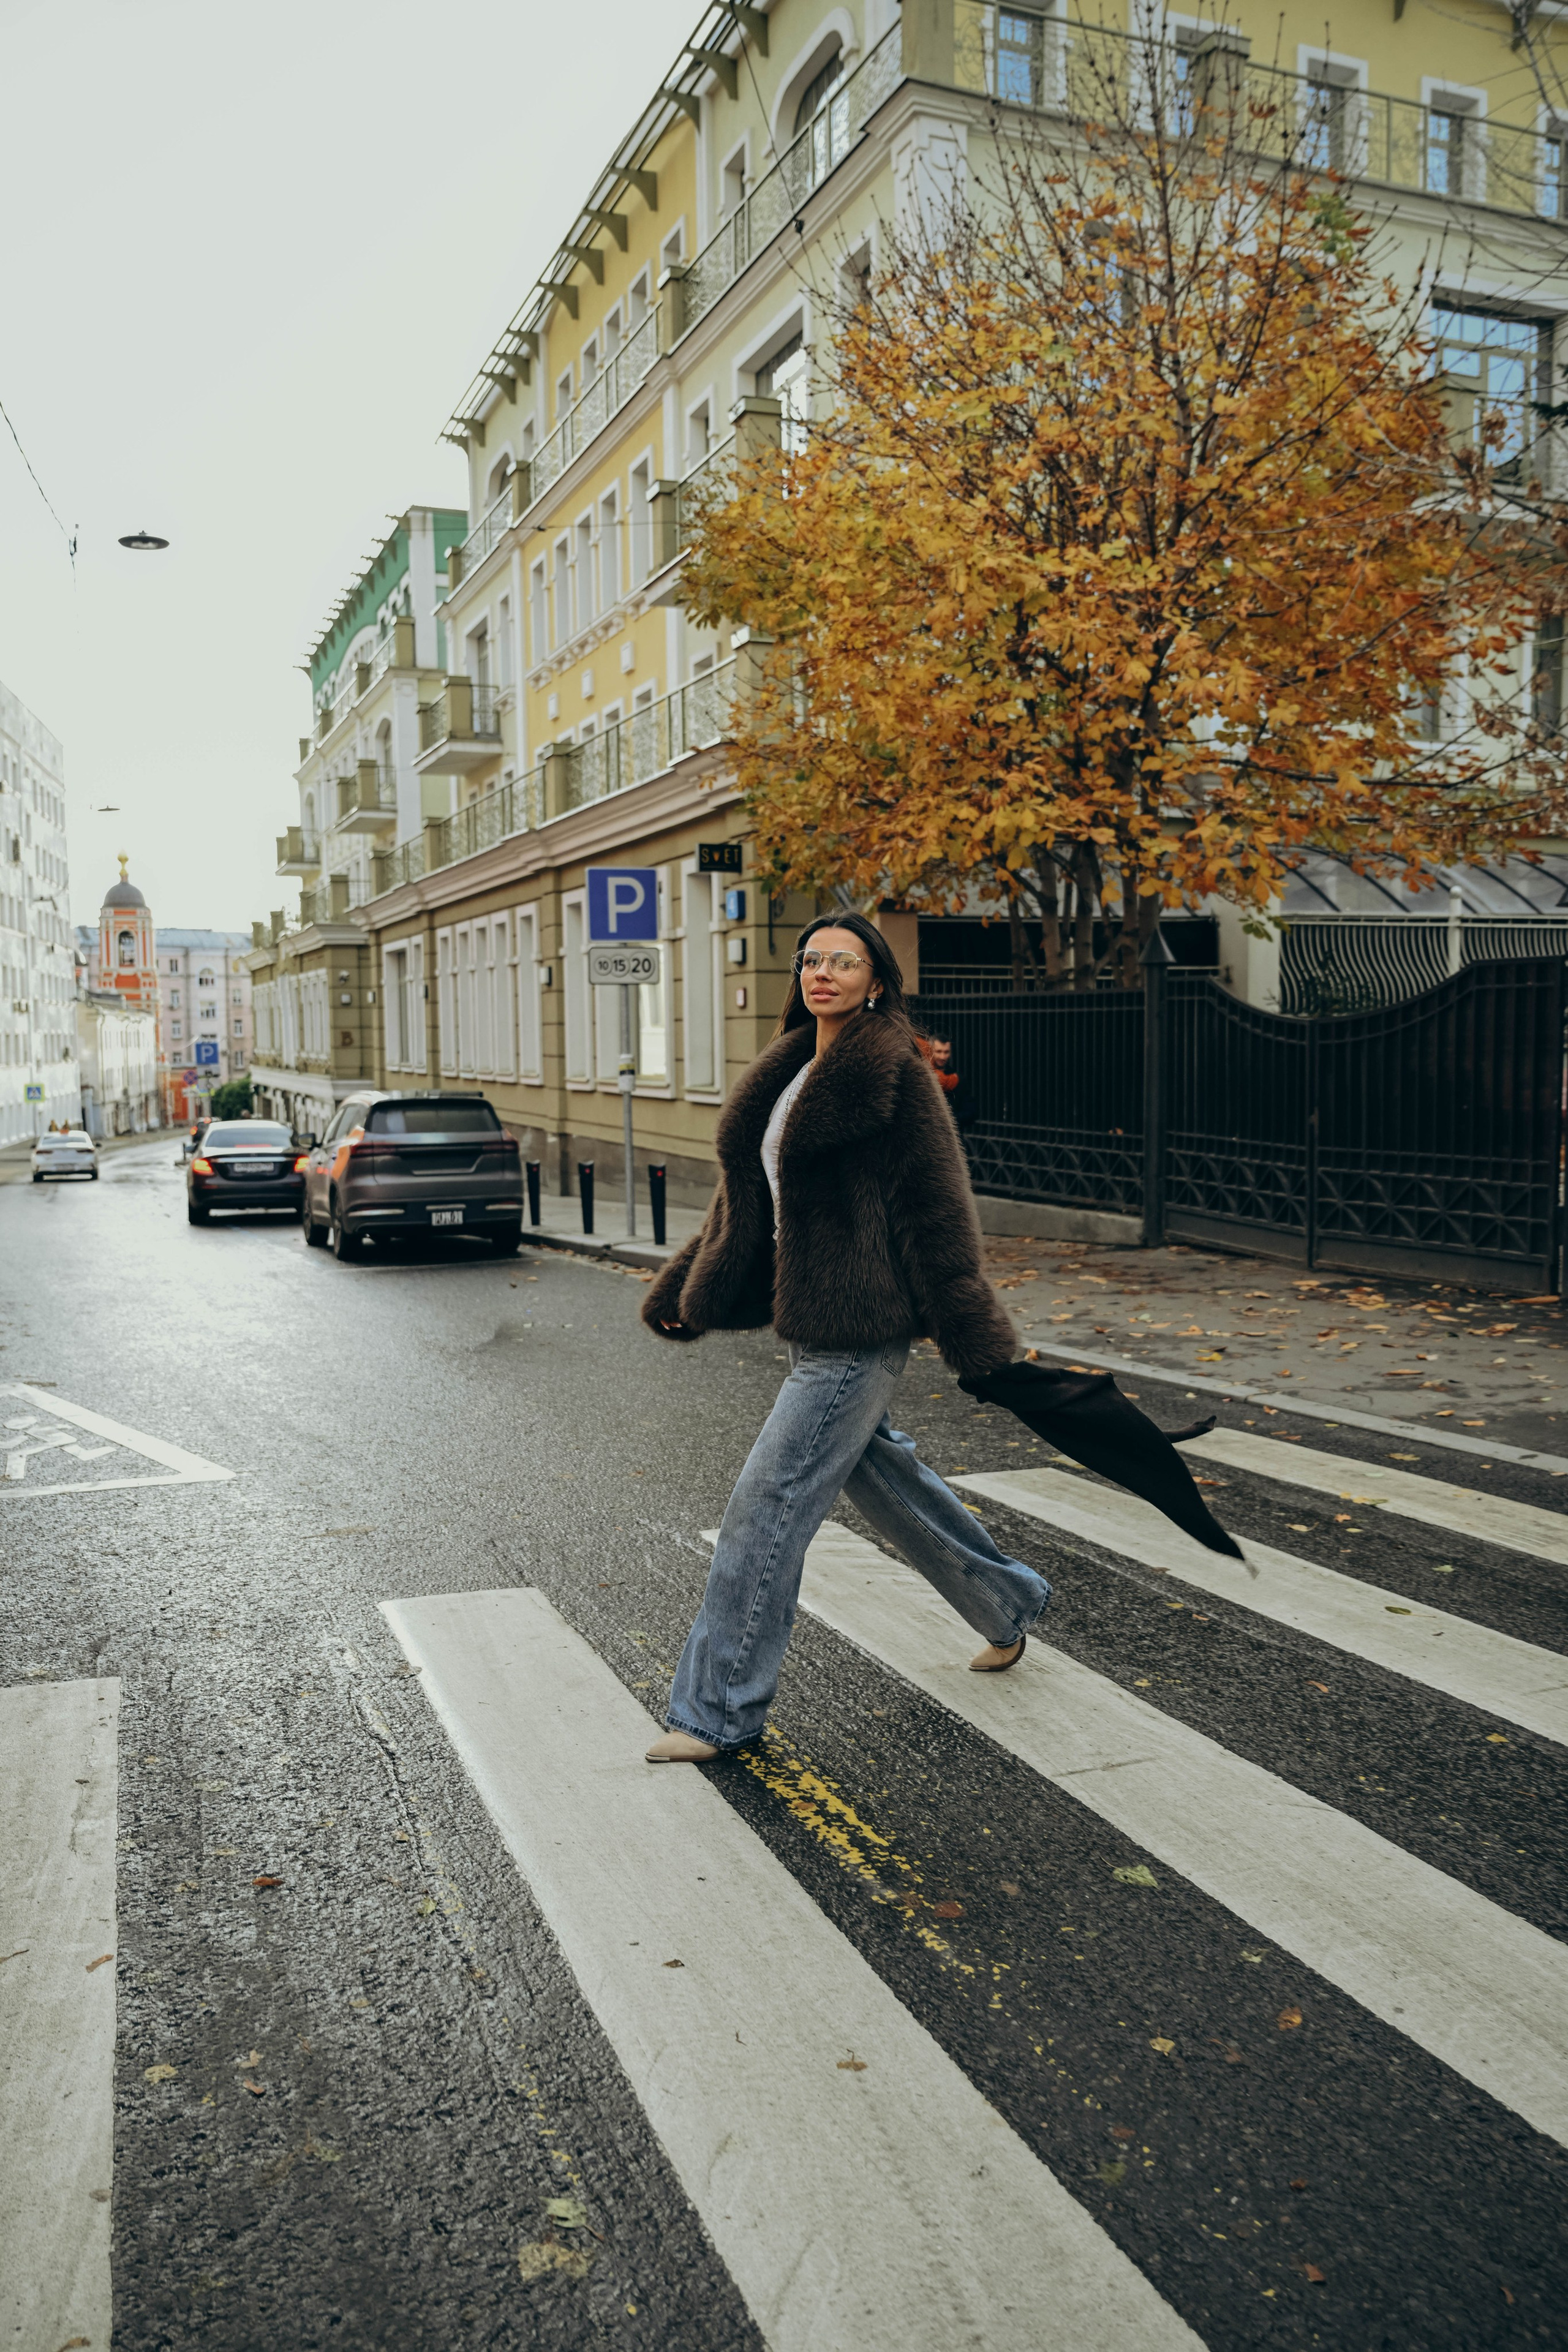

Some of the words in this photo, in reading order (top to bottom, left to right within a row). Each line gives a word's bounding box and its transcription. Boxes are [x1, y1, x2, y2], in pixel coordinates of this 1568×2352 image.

[608, 876, 645, 933] P
[598, 961, 609, 970] 10
[614, 959, 625, 972] 15
[631, 958, 651, 973] 20
[201, 1045, 214, 1063] P
